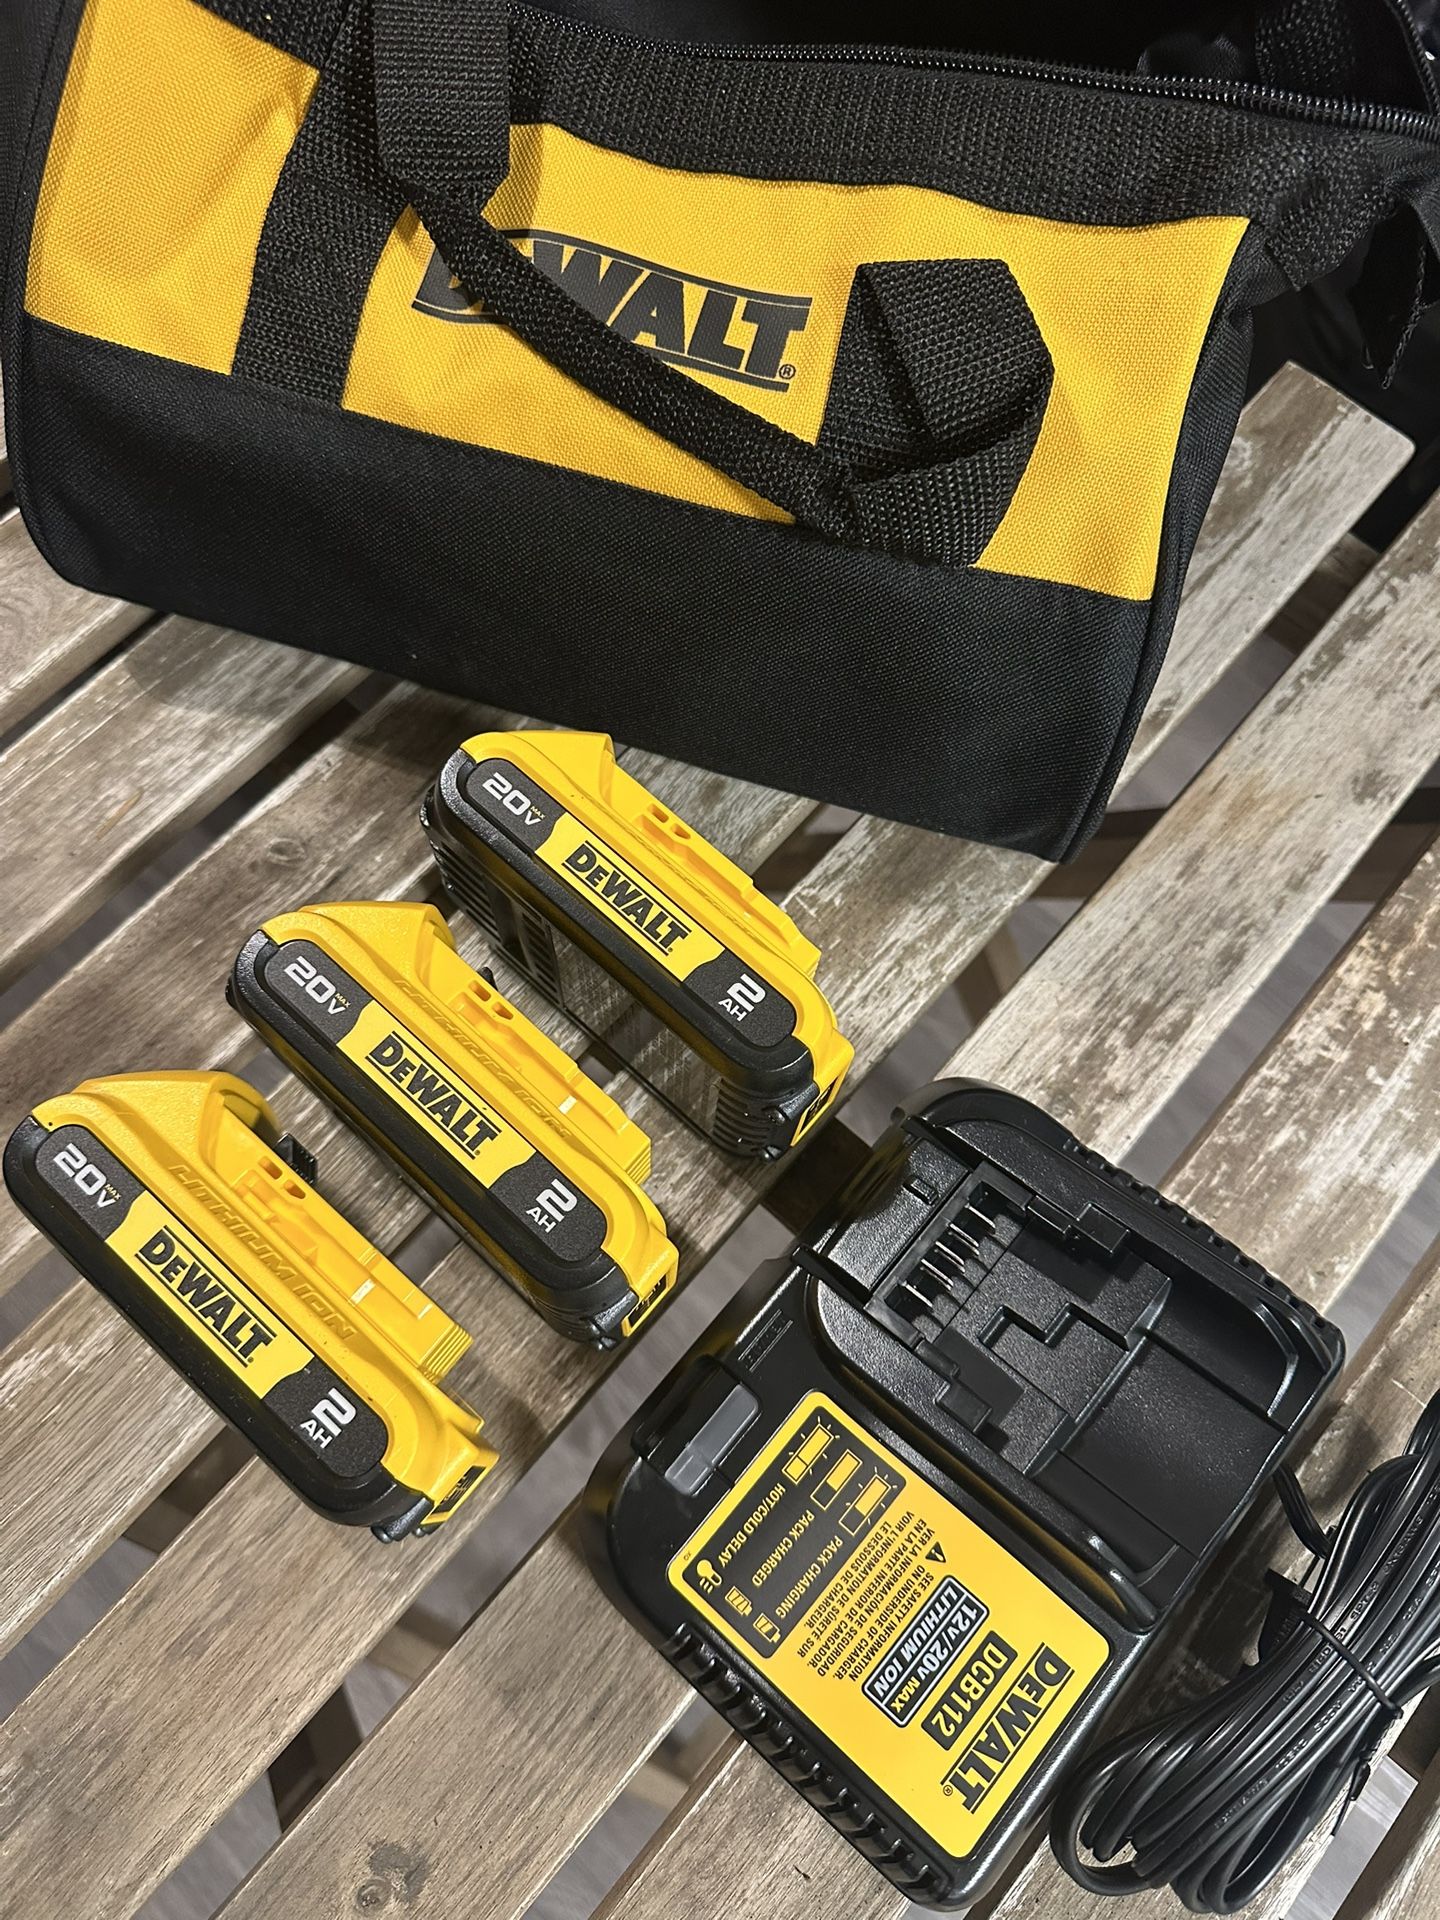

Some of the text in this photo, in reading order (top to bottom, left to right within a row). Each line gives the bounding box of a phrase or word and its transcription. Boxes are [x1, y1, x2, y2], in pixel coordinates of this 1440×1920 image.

[481, 772, 546, 827] 20V MAX
[562, 841, 691, 953] DEWALT
[283, 956, 351, 1016] 20V MAX
[718, 997, 747, 1022] AH
[726, 975, 766, 1012] 2
[367, 1033, 500, 1157] DEWALT
[53, 1142, 122, 1208] 20V MAX
[535, 1179, 577, 1222] 2
[167, 1164, 356, 1341] LITHIUM ION
[526, 1206, 556, 1233] AH
[136, 1227, 276, 1365] DEWALT
[301, 1417, 333, 1449] AH
[312, 1387, 357, 1436] 2
[718, 1483, 786, 1568] HOT/COLD DELAY
[752, 1510, 815, 1587] PACK CHARGED
[895, 1511, 915, 1532] VOIR
[775, 1535, 843, 1619] PACK CHARGING
[804, 1521, 892, 1629] LE DESSOUS DE CHARGEUR.
[807, 1518, 927, 1668] EN LA PARTE INFERIOR DE CARGADOR.
[846, 1530, 899, 1596] L'INFORMATION
[817, 1528, 935, 1677] VER LA INFORMACIÓN DE SEGURIDAD
[833, 1565, 925, 1680] ON UNDERSIDE OF CHARGER.
[836, 1593, 850, 1608] DE
[848, 1572, 934, 1682] SEE SAFETY INFORMATION
[797, 1637, 814, 1658] SUR
[874, 1586, 958, 1697] LITHIUM ION
[890, 1676, 920, 1713] MAX
[931, 1642, 1008, 1737] DCB112
